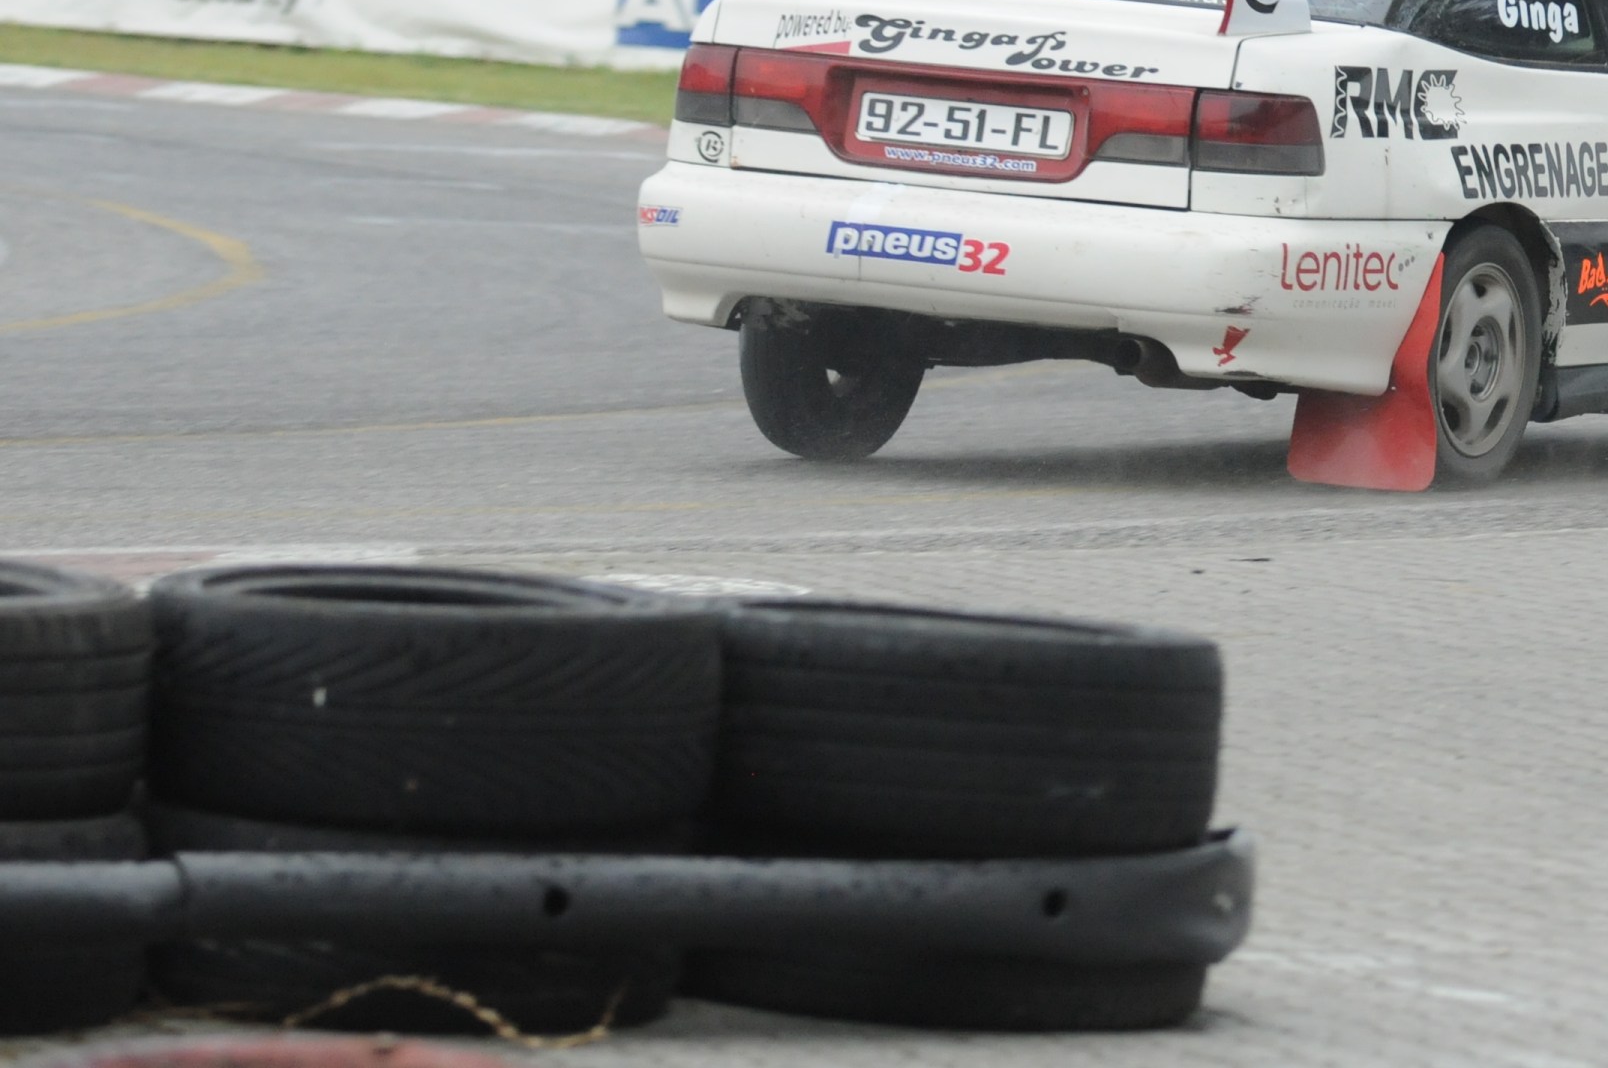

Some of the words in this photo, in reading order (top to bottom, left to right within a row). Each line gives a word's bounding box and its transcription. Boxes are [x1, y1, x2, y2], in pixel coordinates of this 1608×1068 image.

[854, 12, 1019, 55] Ginga
[1005, 30, 1160, 79] Power
[865, 98, 1059, 151] 92-51-FL
[1330, 65, 1468, 140] RMC
[884, 146, 1037, 172] www.pneus32.com
